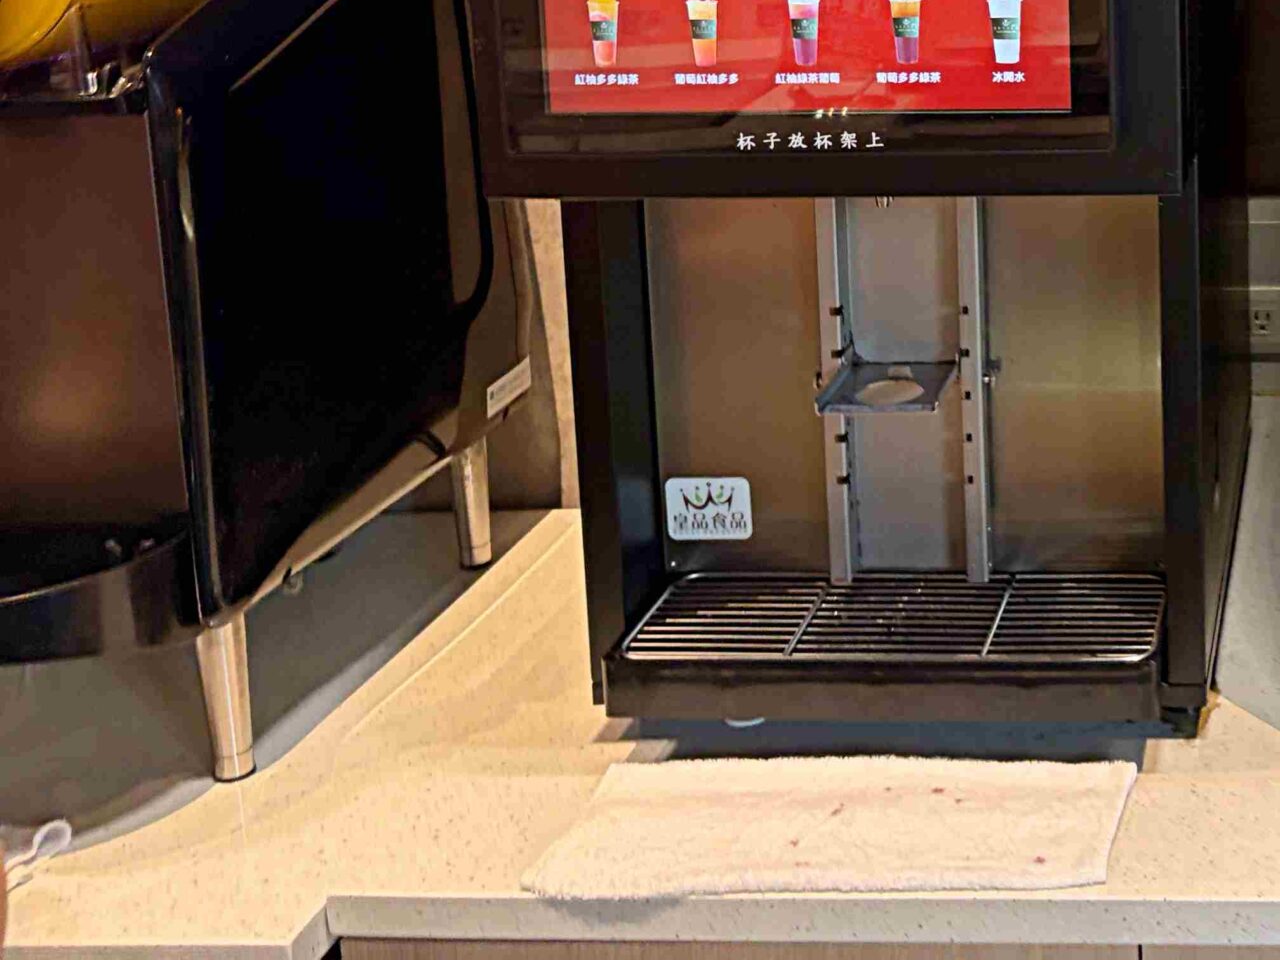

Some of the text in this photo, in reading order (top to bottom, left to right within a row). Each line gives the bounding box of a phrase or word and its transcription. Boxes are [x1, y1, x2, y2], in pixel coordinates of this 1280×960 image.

[736, 131, 885, 150] 杯子放杯架上
